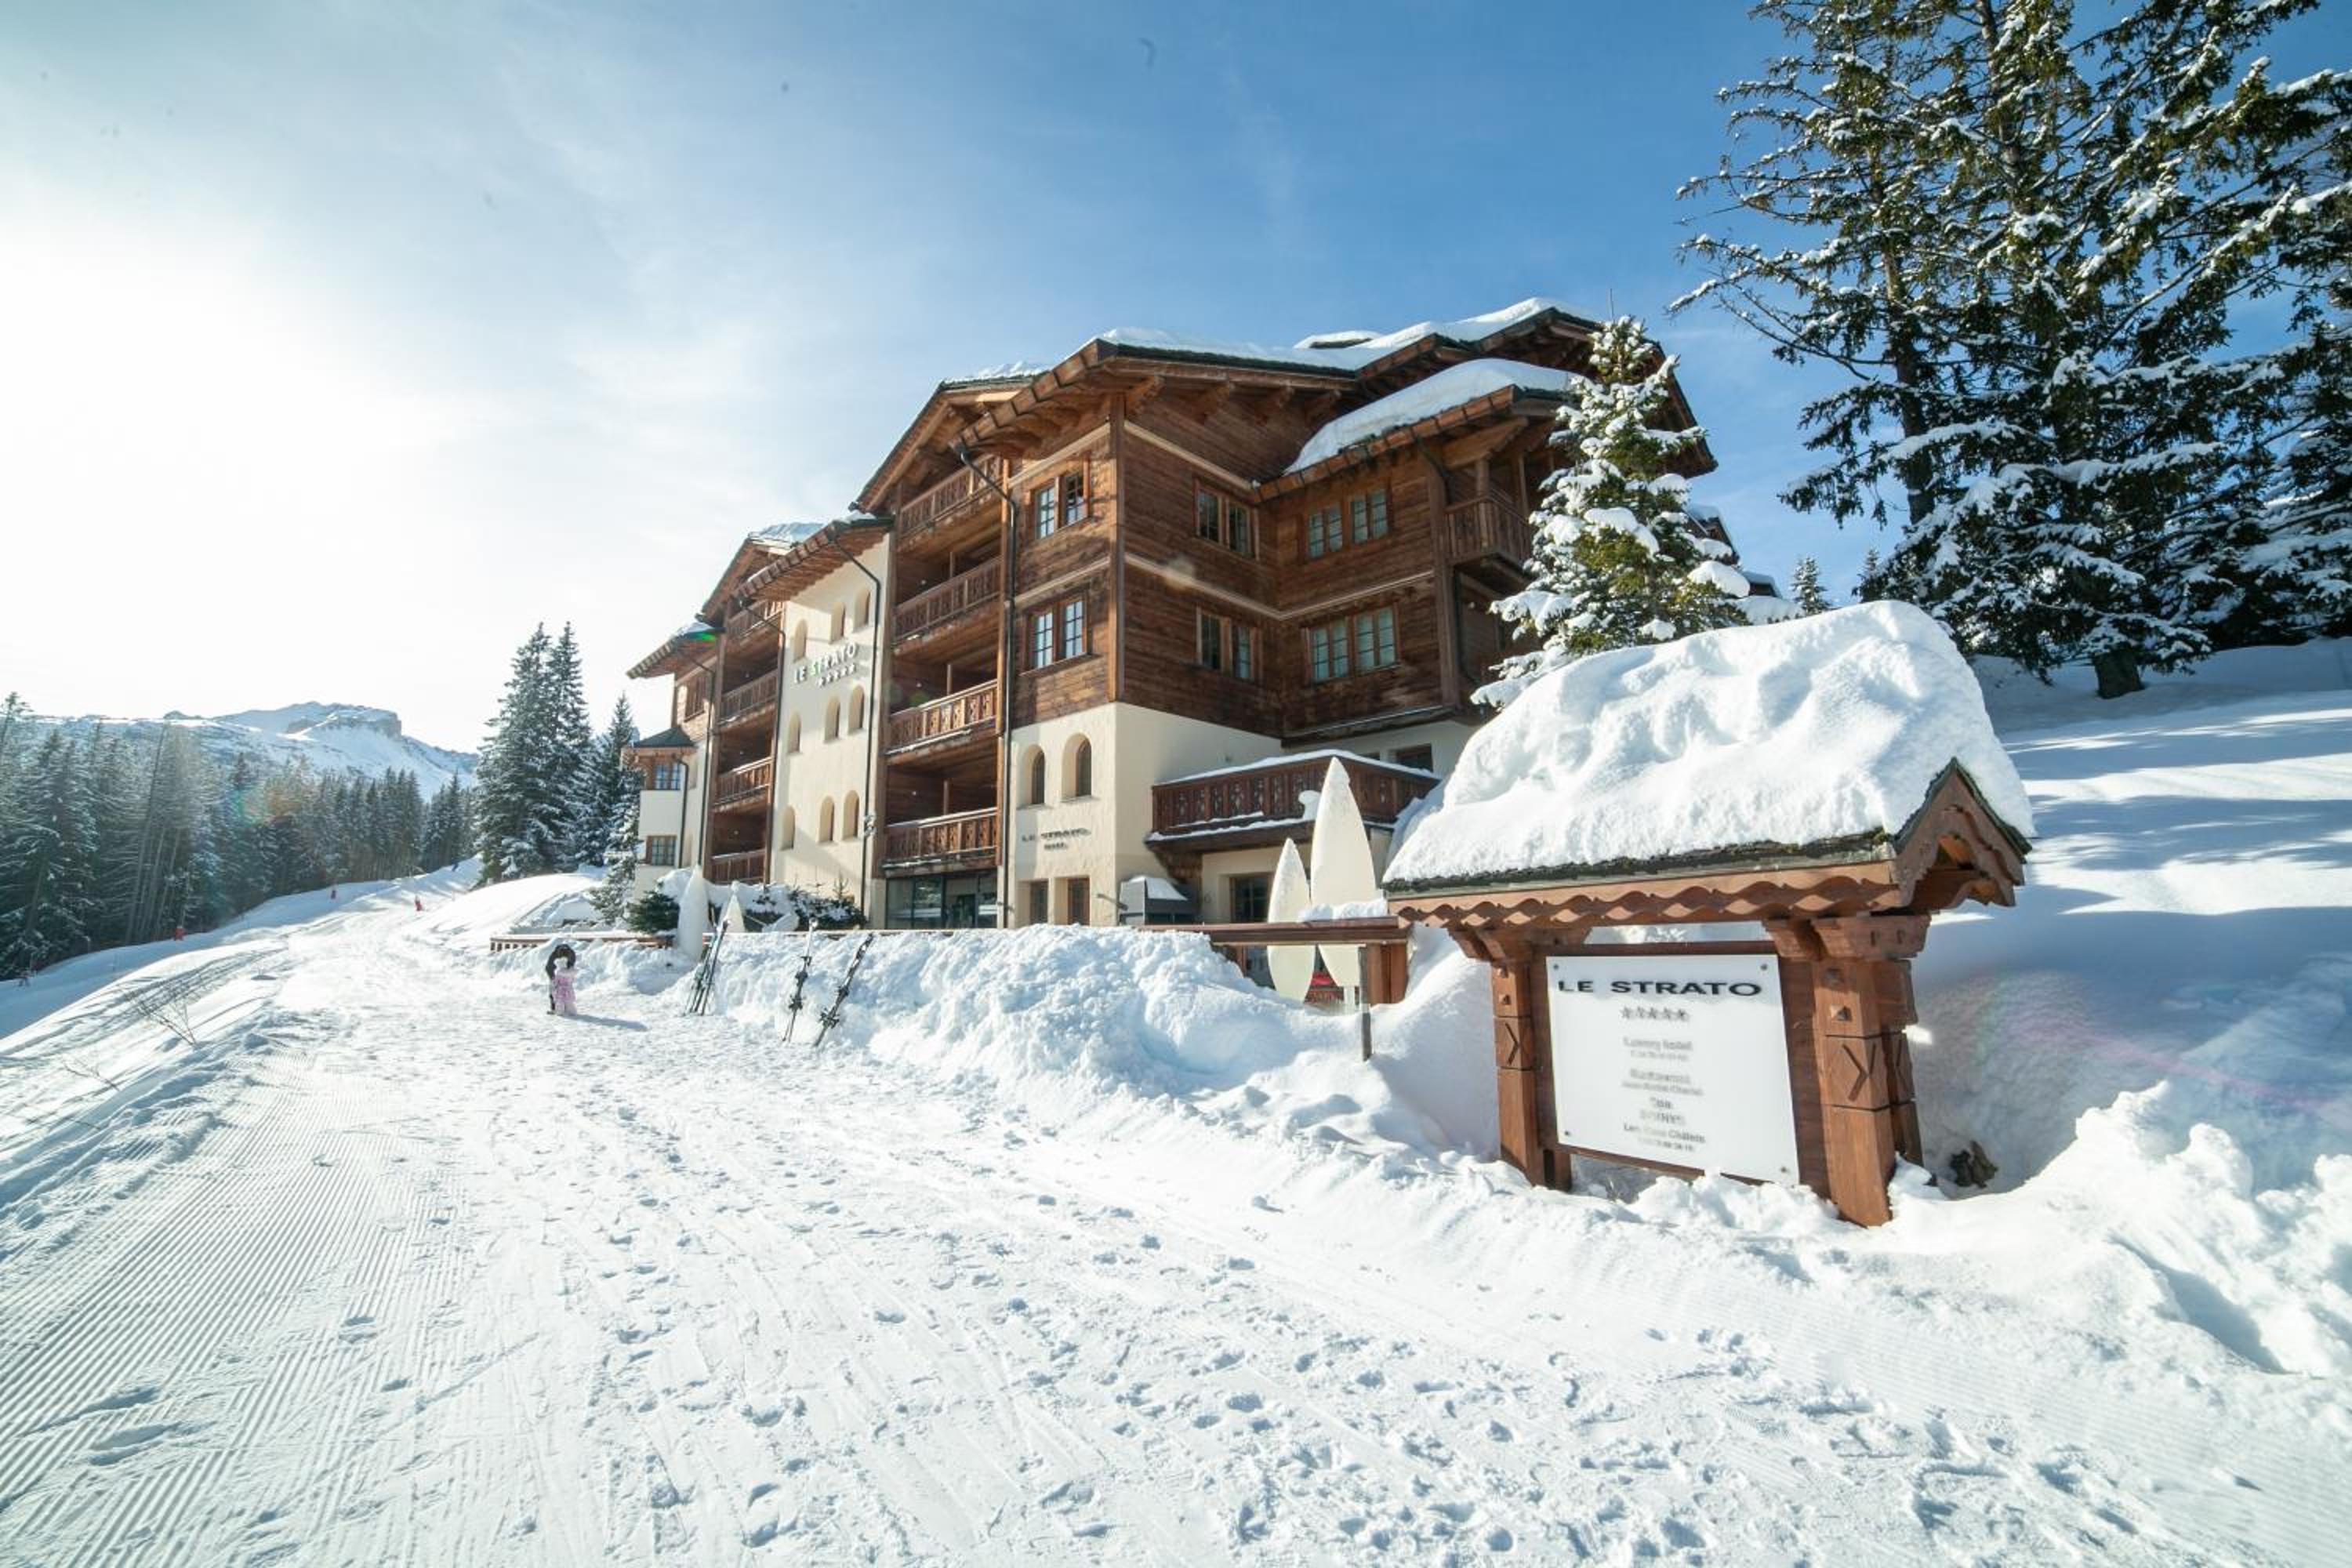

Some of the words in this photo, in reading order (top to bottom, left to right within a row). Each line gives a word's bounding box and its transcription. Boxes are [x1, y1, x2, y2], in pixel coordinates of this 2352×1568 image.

[793, 666, 807, 684] LE
[810, 642, 857, 677] STRATO
[1558, 980, 1594, 993] LE
[1610, 980, 1762, 996] STRATO
